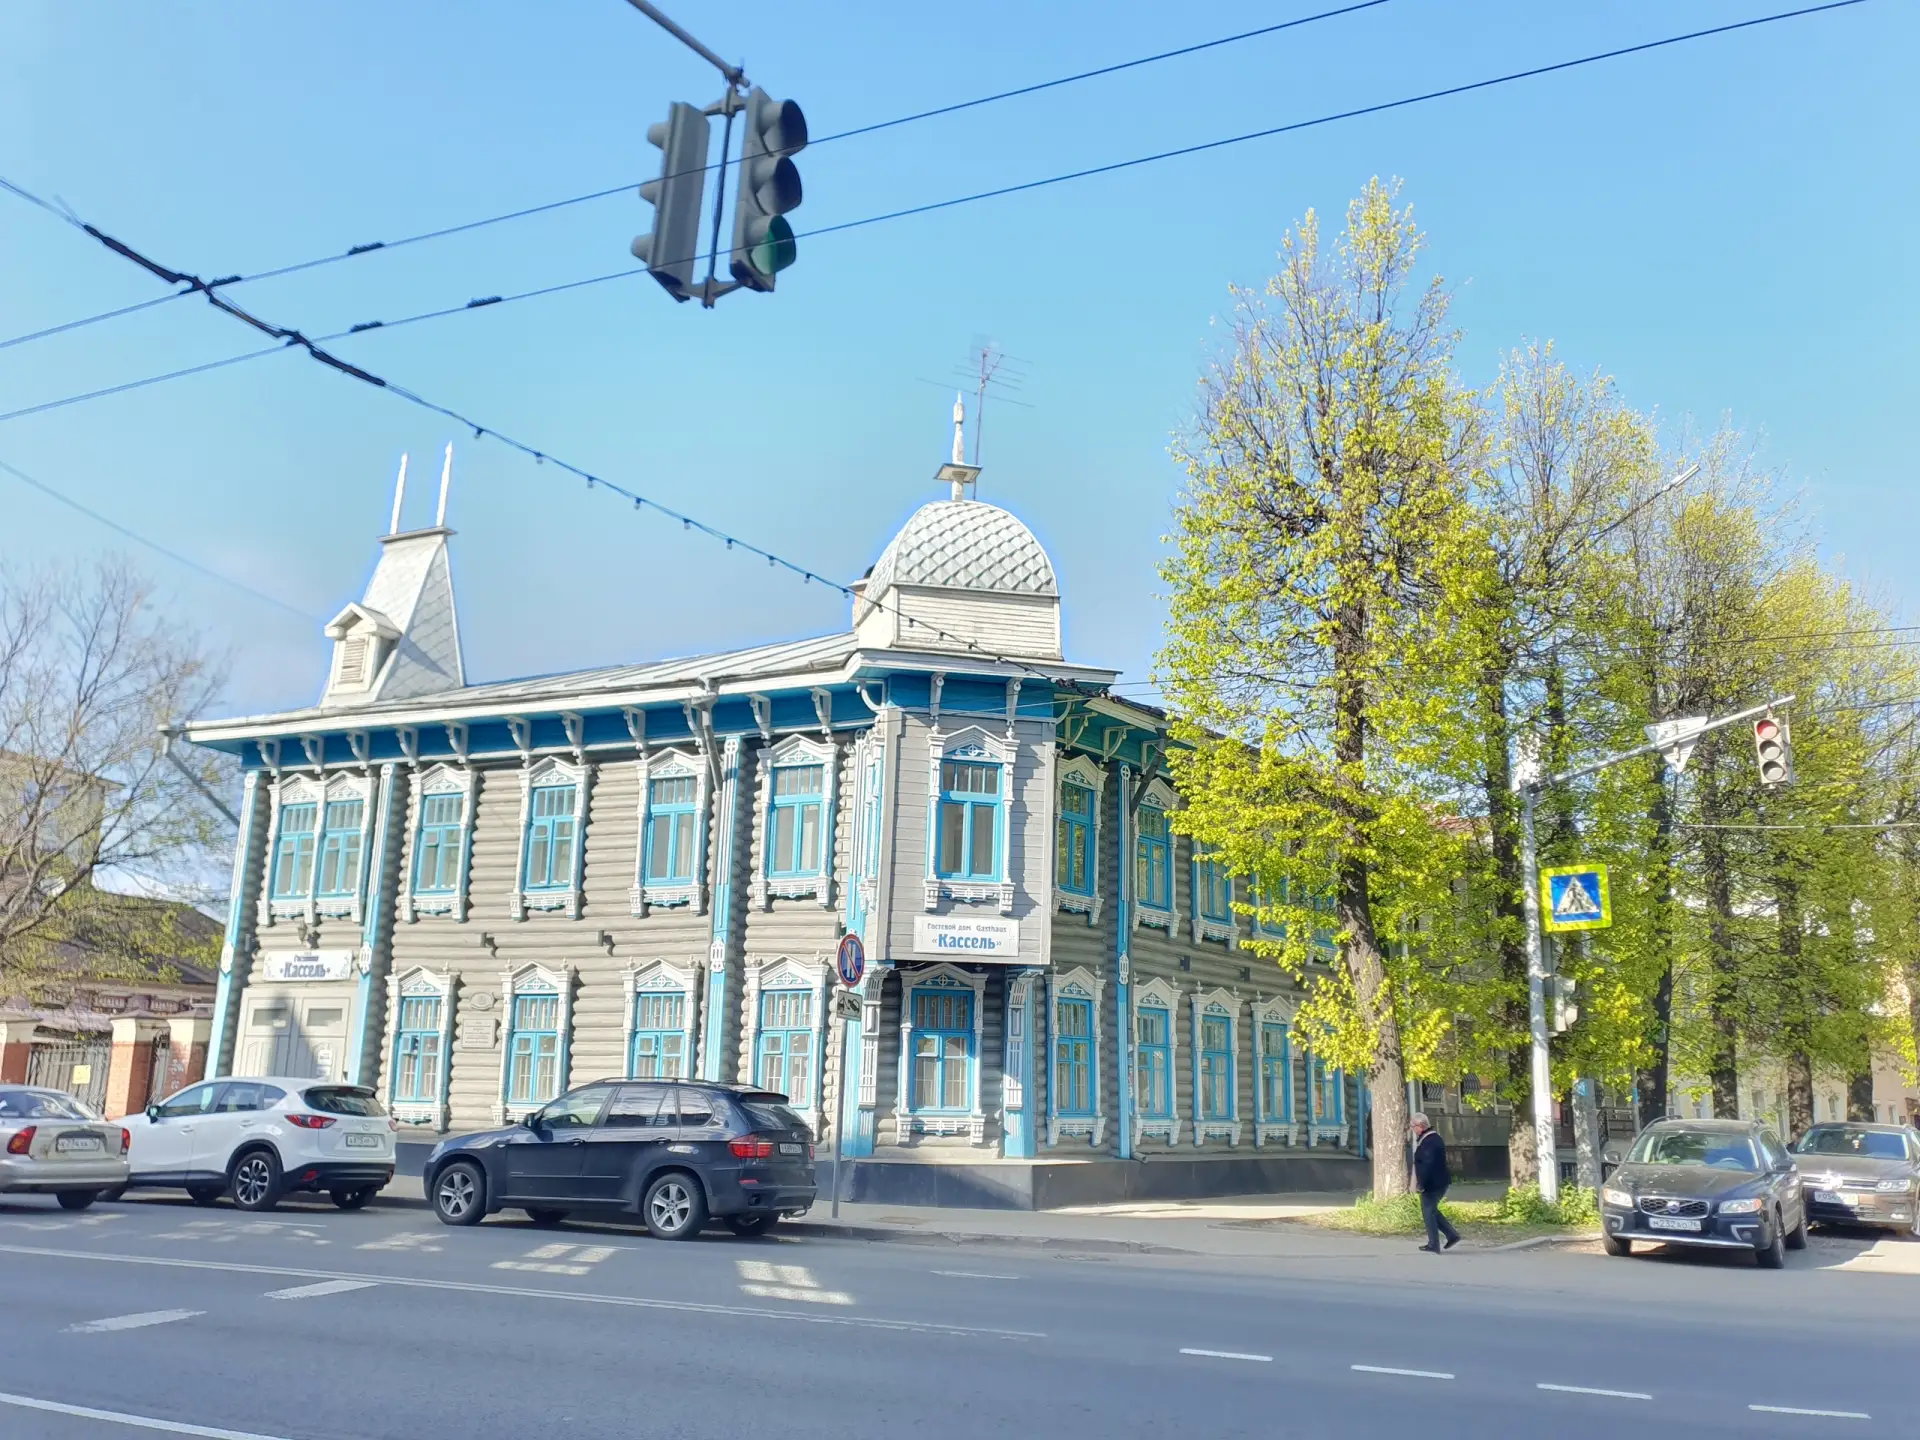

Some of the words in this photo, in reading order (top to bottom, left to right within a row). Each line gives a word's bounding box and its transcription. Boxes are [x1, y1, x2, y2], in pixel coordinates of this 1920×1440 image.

[927, 922, 956, 931] Гостевой
[957, 924, 972, 932] дом
[975, 924, 1007, 933] Gasthaus
[931, 933, 1002, 950] «Кассель»
